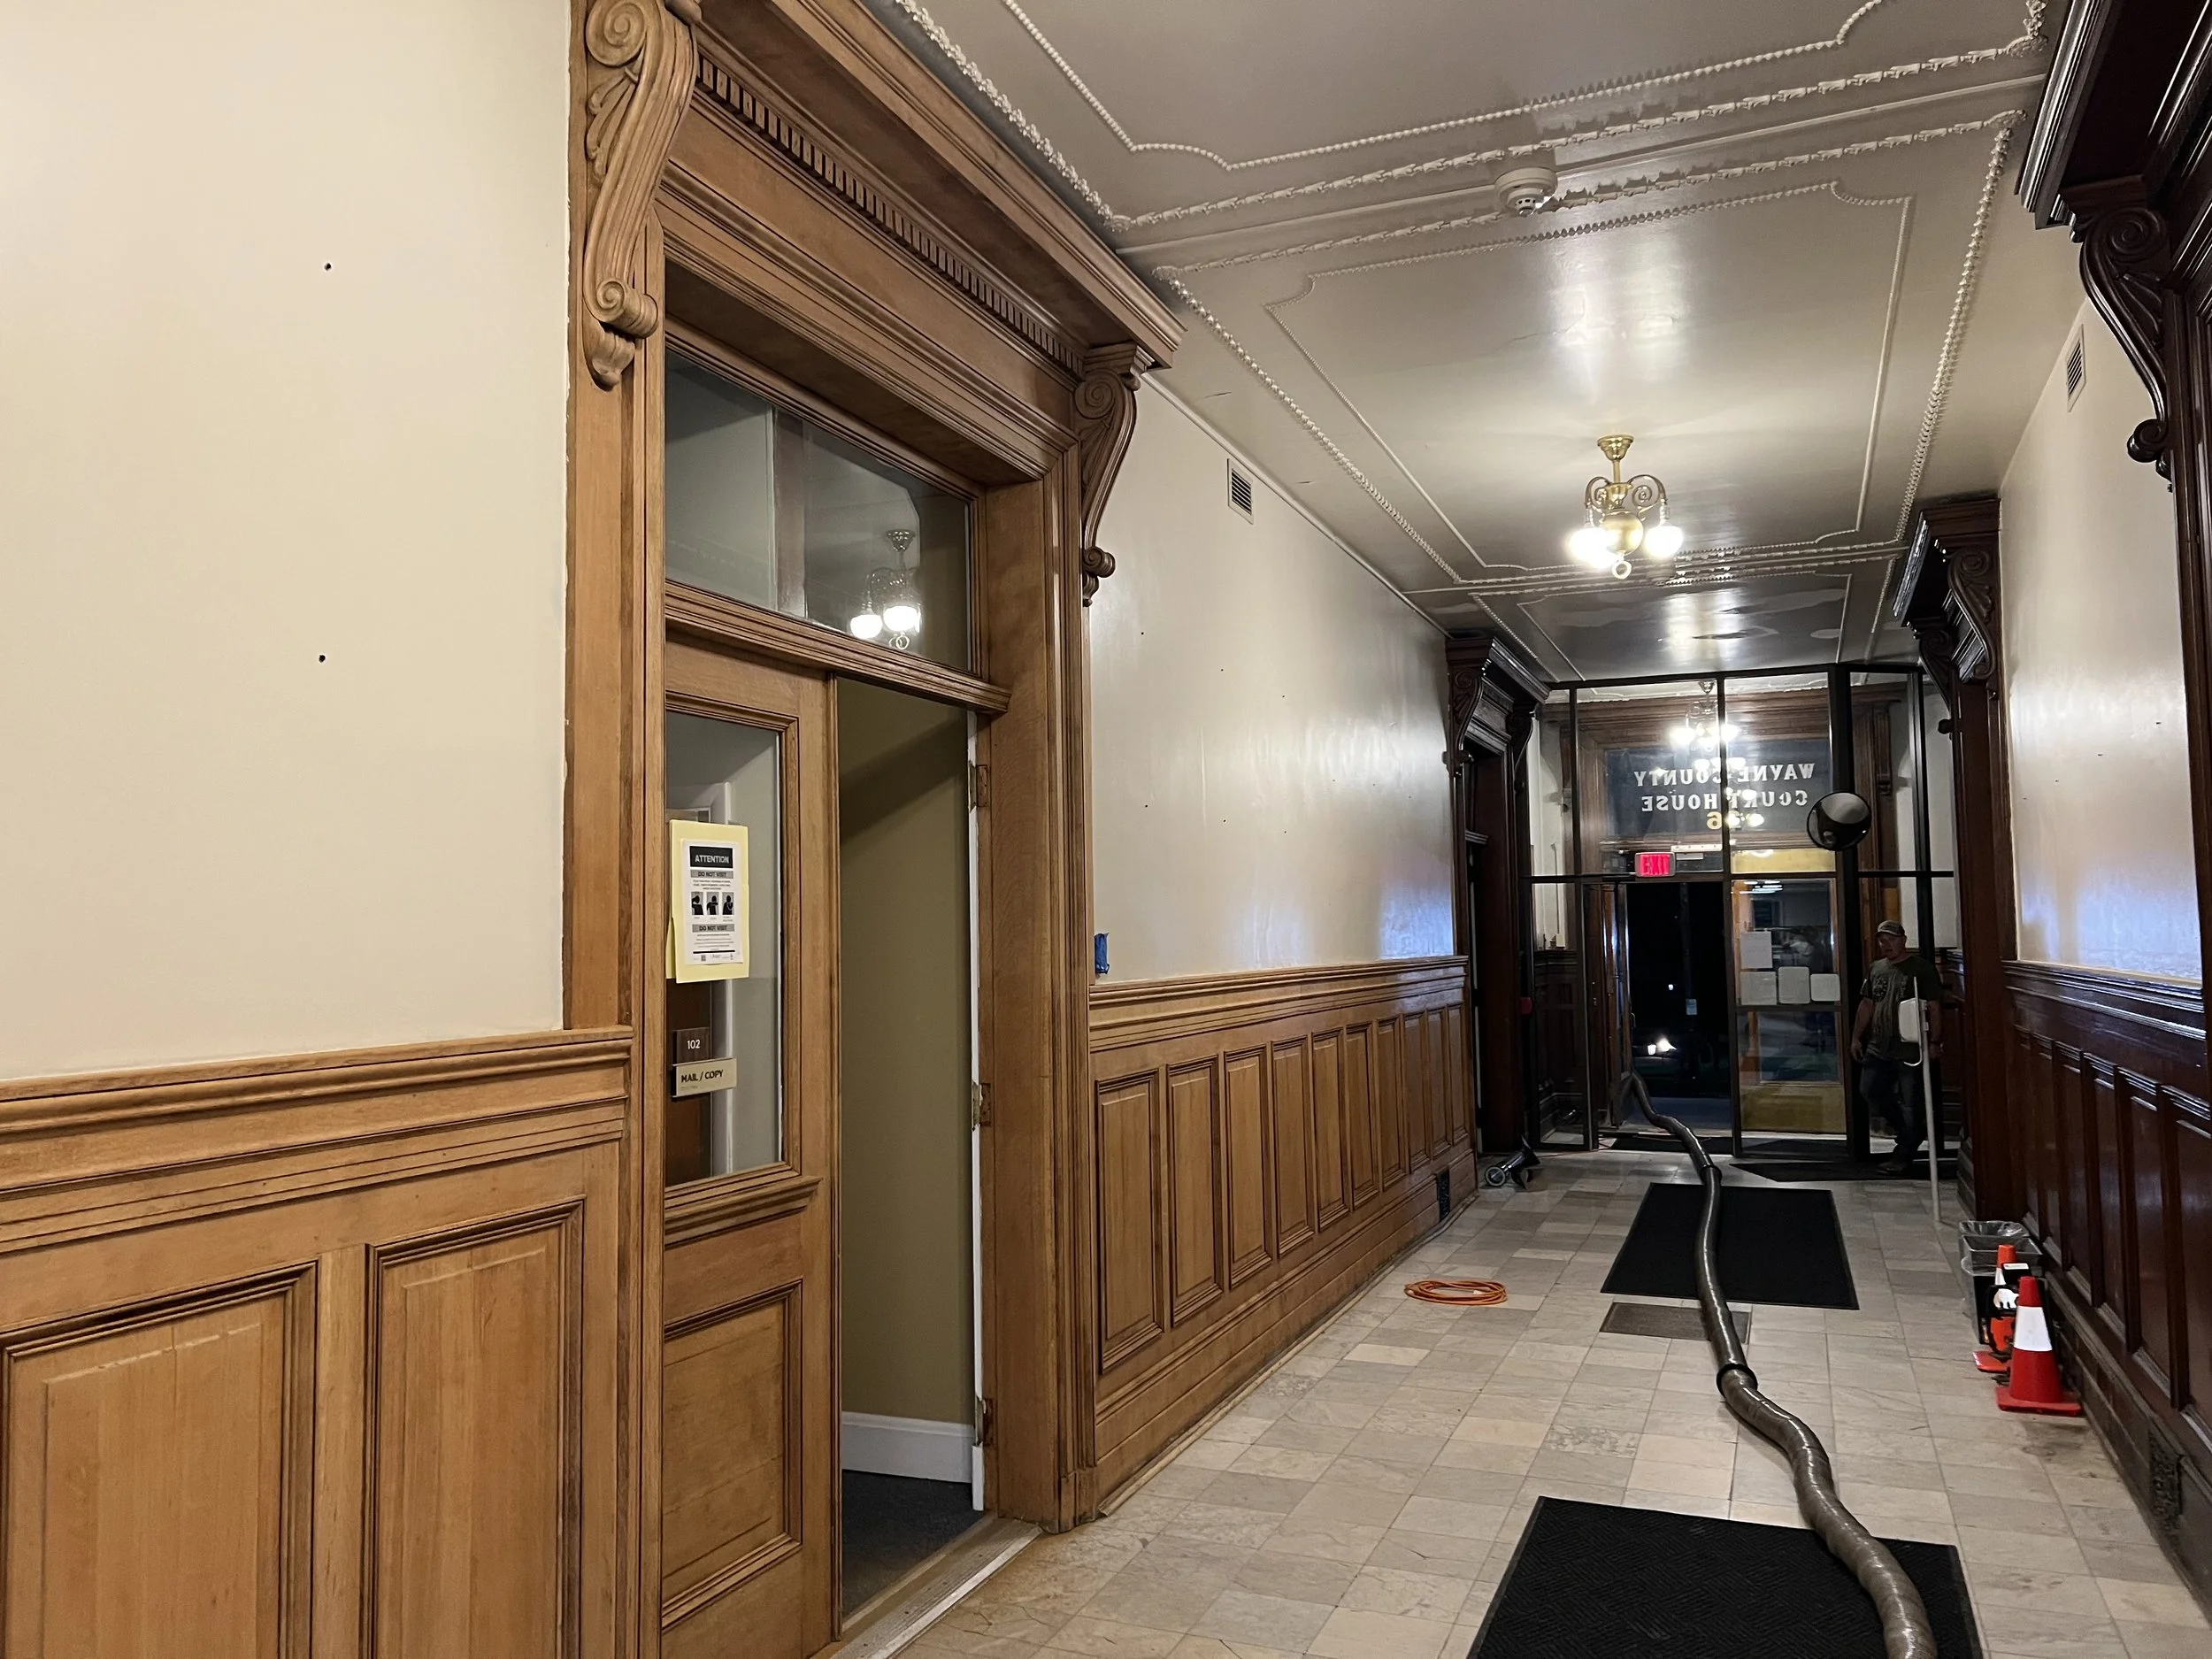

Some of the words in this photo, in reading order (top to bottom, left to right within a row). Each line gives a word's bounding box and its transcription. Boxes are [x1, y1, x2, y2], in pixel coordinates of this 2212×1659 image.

[695, 854, 730, 864] ATTENTION
[1640, 854, 1671, 875] EXIT
[687, 1039, 701, 1049] 102
[681, 1073, 699, 1083] MAIL
[699, 1071, 704, 1081] /
[704, 1070, 723, 1079] COPY
